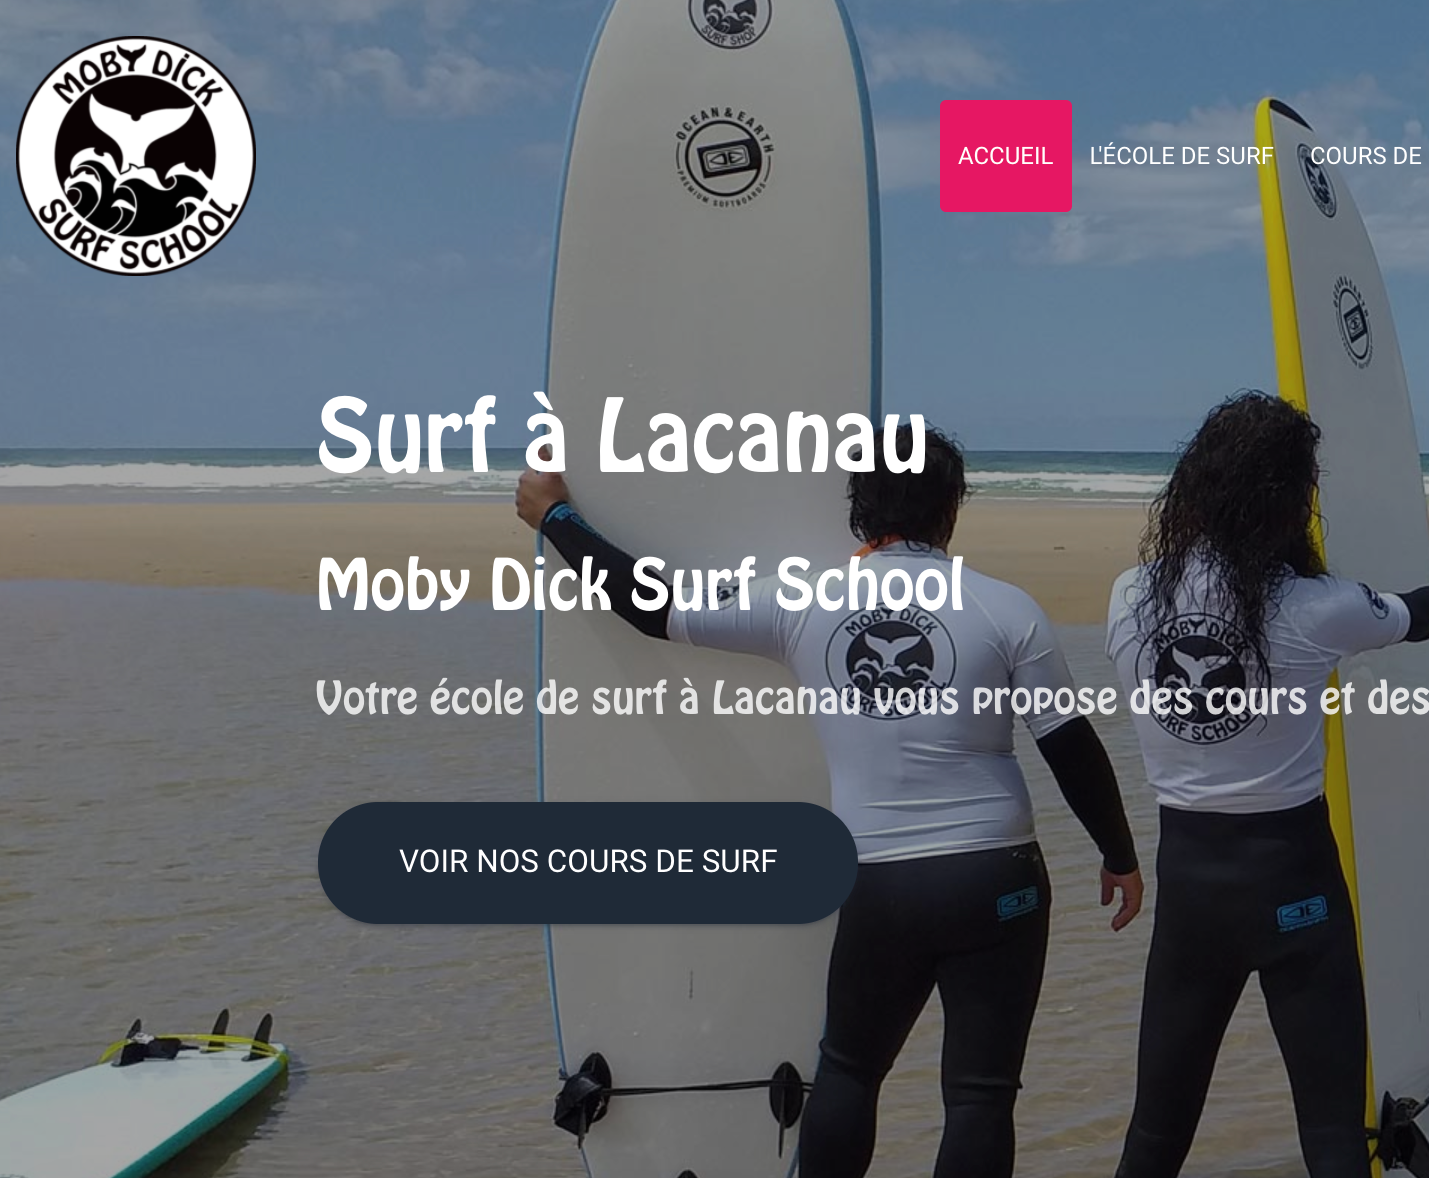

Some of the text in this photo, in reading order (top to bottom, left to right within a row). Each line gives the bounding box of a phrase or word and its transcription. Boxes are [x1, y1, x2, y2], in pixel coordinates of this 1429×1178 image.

[701, 24, 728, 44] SURF
[676, 107, 774, 153] OCEAN & EARTH
[845, 606, 938, 637] MOBY DICK
